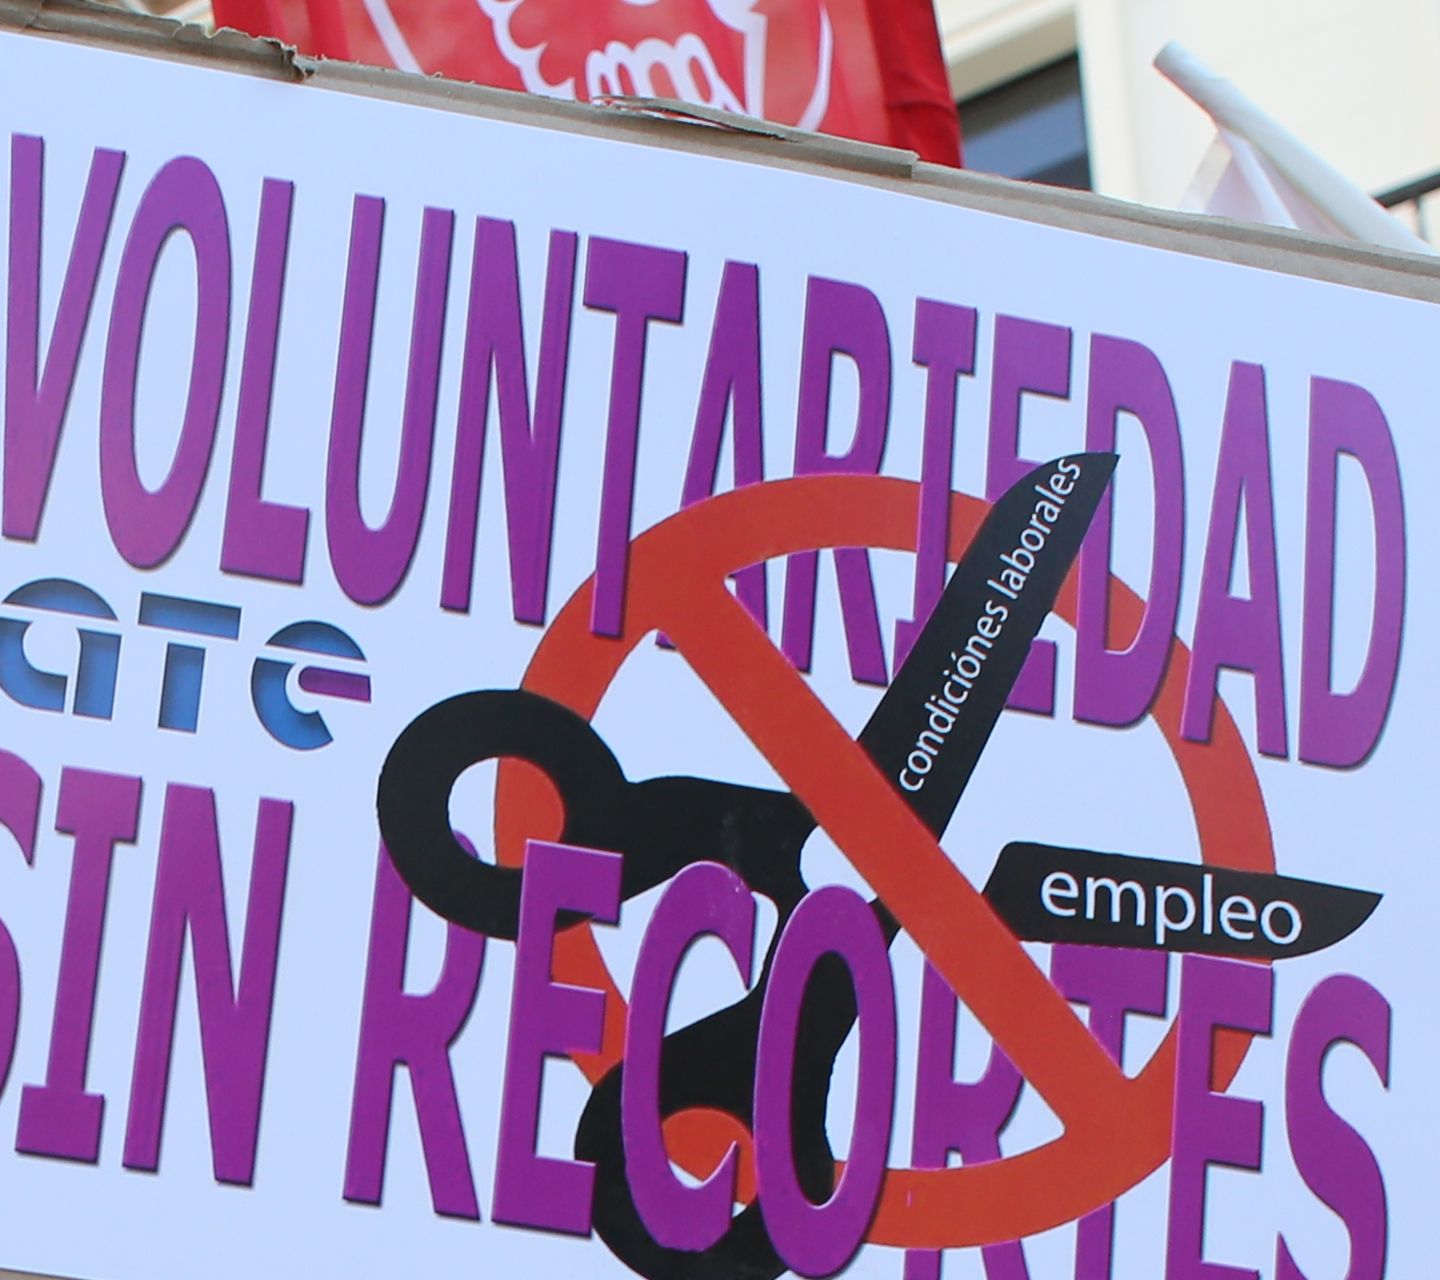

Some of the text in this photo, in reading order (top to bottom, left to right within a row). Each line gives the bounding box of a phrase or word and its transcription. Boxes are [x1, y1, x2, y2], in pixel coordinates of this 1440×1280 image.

[1, 133, 1407, 771] VOLUNTARIEDAD
[898, 456, 1084, 794] condiciónes laborales
[1039, 870, 1304, 944] empleo
